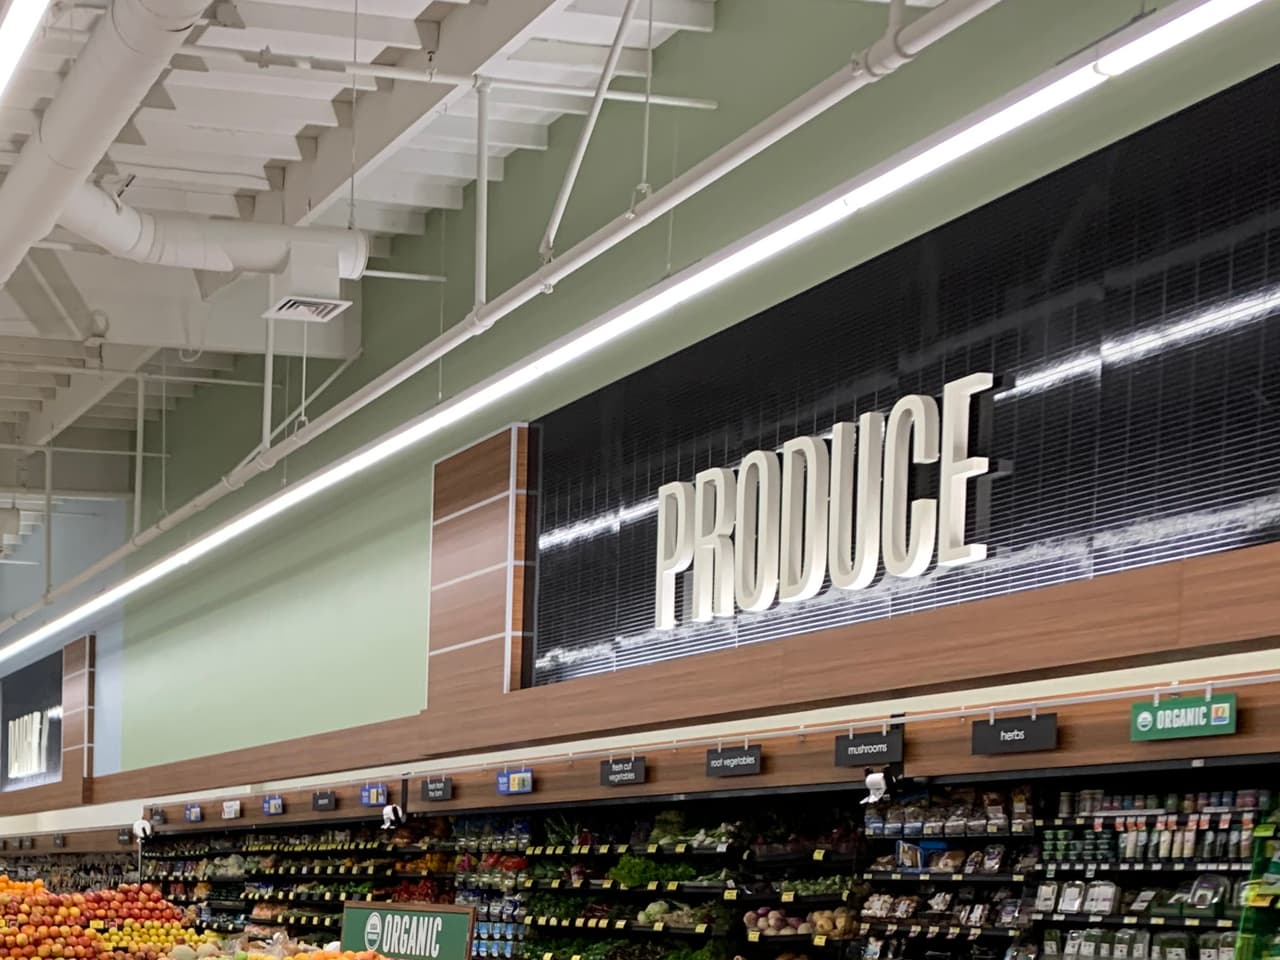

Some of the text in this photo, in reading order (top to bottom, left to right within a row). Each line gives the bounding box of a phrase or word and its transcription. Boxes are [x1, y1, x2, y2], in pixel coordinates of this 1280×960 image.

[655, 372, 994, 630] PRODUCE
[1156, 706, 1208, 729] ORGANIC
[1000, 730, 1025, 741] herbs
[848, 743, 888, 755] mushrooms
[382, 913, 442, 958] ORGANIC
